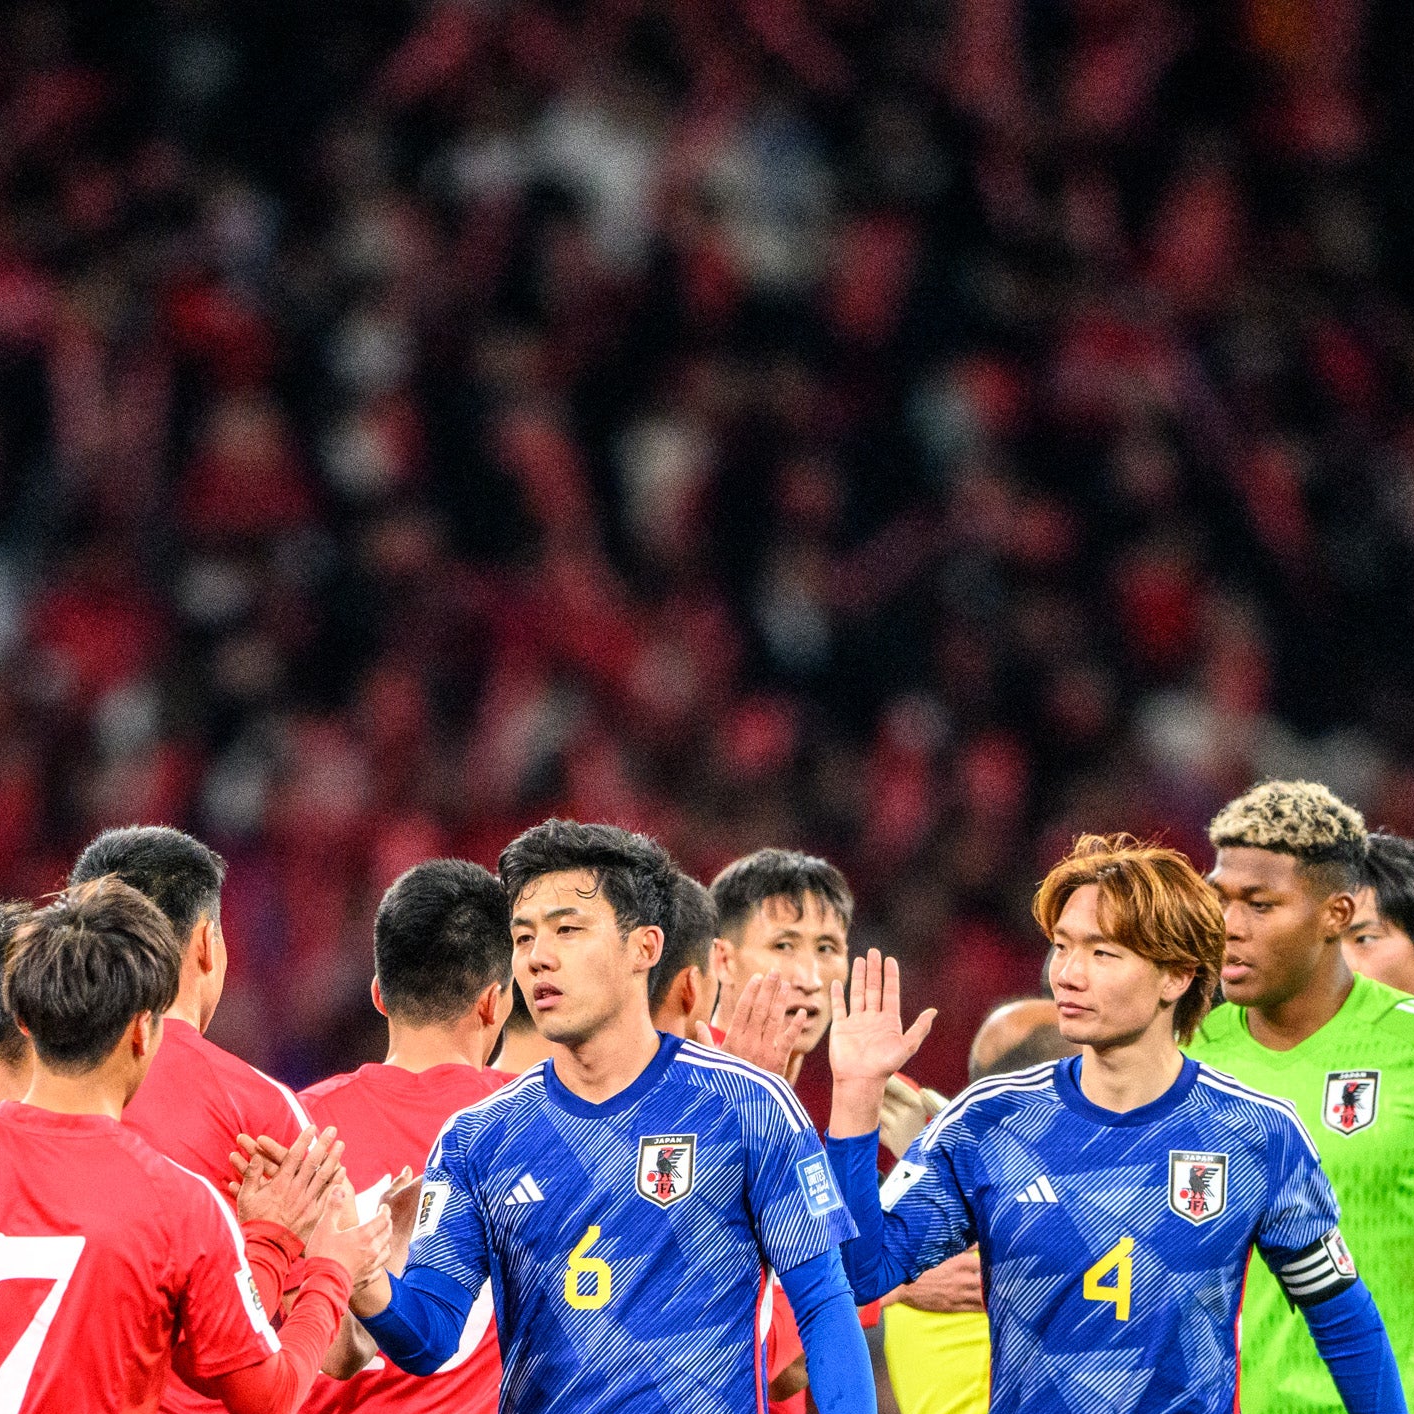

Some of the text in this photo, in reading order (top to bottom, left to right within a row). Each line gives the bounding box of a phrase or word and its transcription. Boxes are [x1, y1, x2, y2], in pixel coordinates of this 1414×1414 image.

[1183, 1154, 1214, 1162] JAPAN
[651, 1183, 677, 1194] JFA
[1185, 1200, 1210, 1212] JFA
[564, 1226, 611, 1310] 6
[1083, 1237, 1134, 1321] 4
